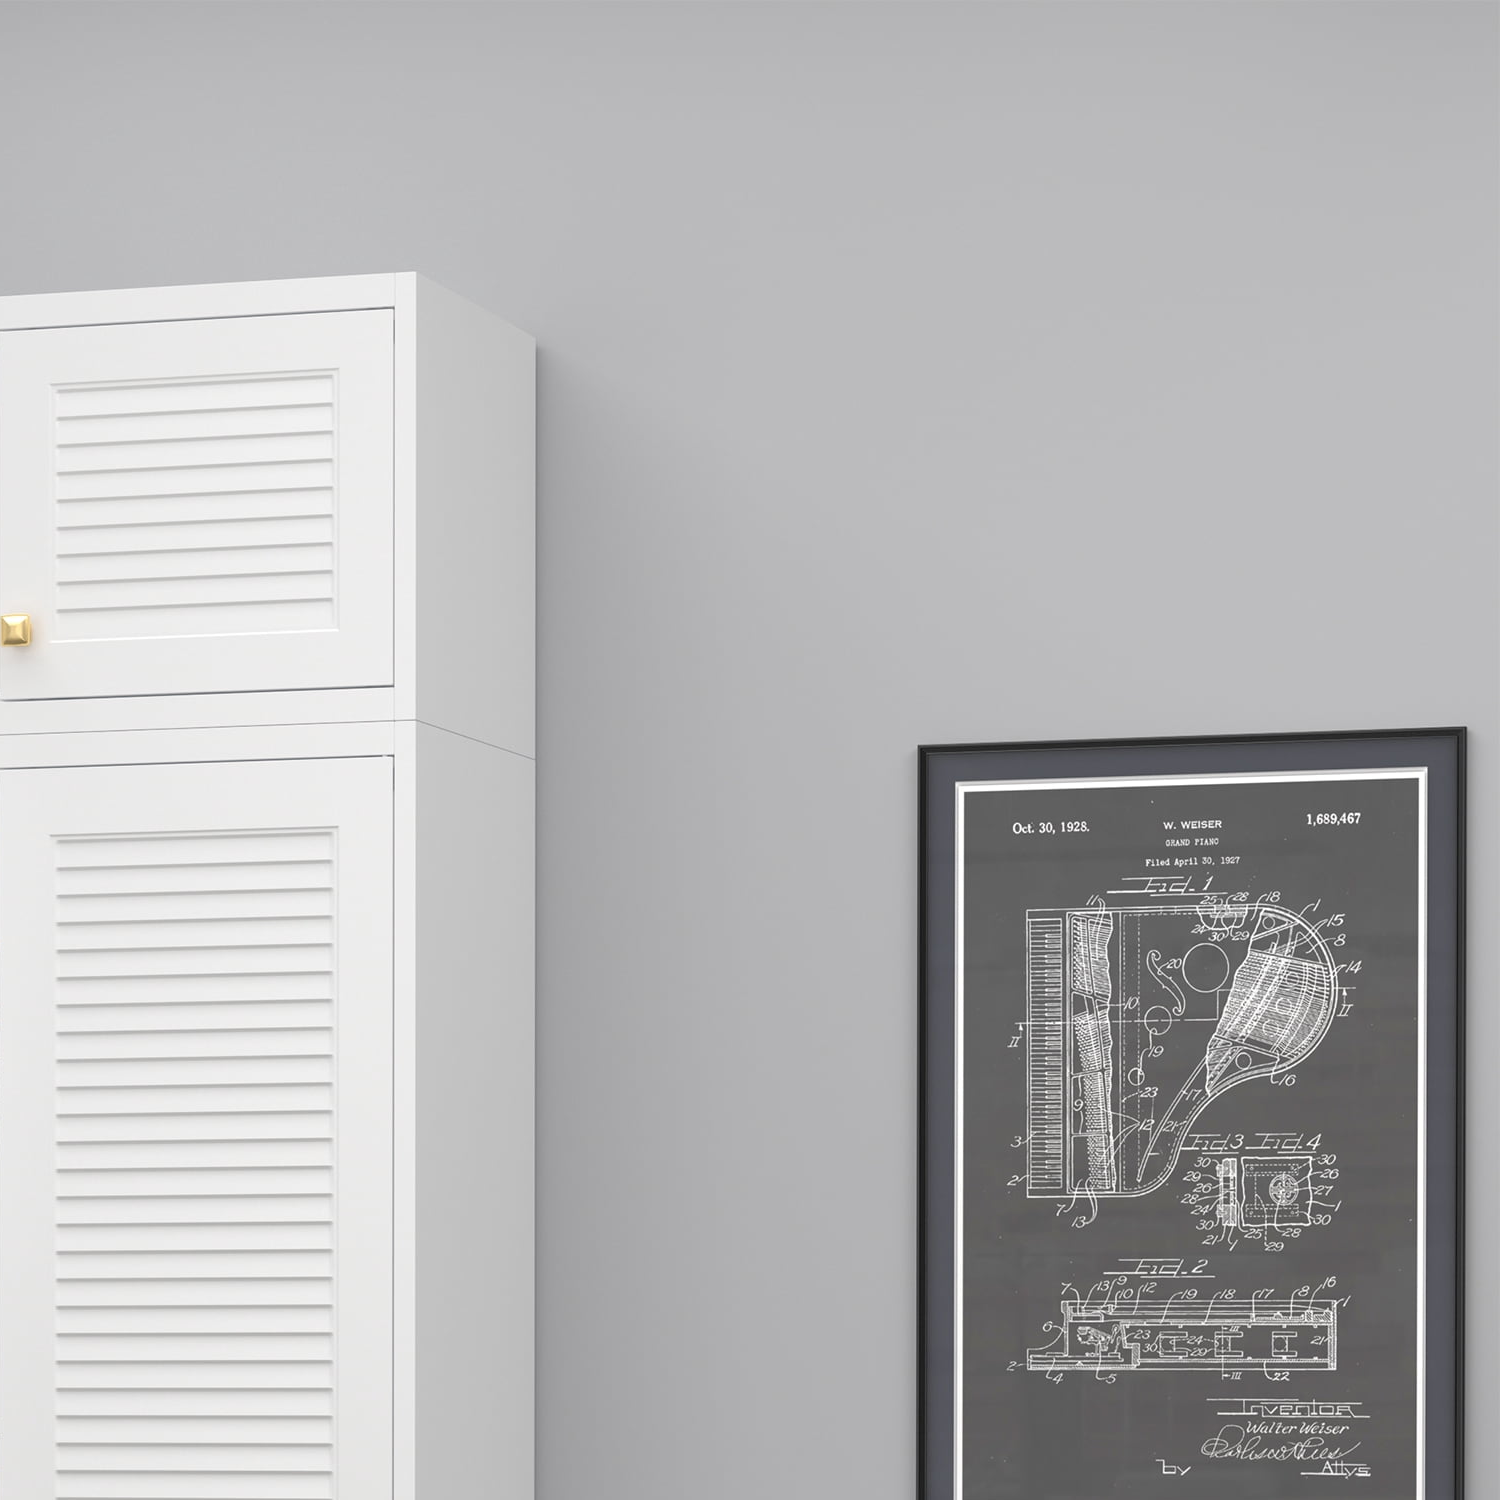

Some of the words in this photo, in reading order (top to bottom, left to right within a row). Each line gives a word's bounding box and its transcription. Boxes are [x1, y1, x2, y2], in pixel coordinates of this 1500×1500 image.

[1163, 821, 1177, 830] W.
[1181, 820, 1222, 829] WEISER
[1306, 813, 1361, 827] 1,689,467
[1012, 822, 1035, 834] Oct.
[1039, 822, 1056, 835] 30,
[1061, 821, 1090, 832] 1928.
[1165, 839, 1190, 847] GRAND
[1194, 838, 1219, 846] PIANO
[1145, 858, 1170, 867] Filed
[1174, 857, 1198, 868] April
[1202, 857, 1215, 866] 30,
[1202, 876, 1213, 891] 1
[1200, 896, 1217, 904] 25
[1233, 892, 1249, 901] 28
[1266, 891, 1281, 902] 18
[1327, 914, 1345, 927] 15
[1191, 925, 1205, 934] 24
[1208, 932, 1225, 941] 30
[1232, 931, 1250, 941] 29
[1334, 934, 1346, 946] 8
[1166, 958, 1182, 969] 20
[1345, 960, 1362, 974] 14
[1124, 997, 1139, 1010] 10
[1148, 1046, 1164, 1057] 19
[1279, 1074, 1296, 1086] 16
[1139, 1087, 1158, 1097] 23
[1073, 1099, 1084, 1111] 9
[1138, 1119, 1155, 1131] 12
[1010, 1136, 1022, 1148] 3
[1230, 1134, 1244, 1149] 3
[1306, 1133, 1321, 1150] 4
[1194, 1159, 1211, 1167] 30
[1317, 1154, 1336, 1165] 30
[1183, 1171, 1201, 1182] 29
[1320, 1169, 1339, 1179] 26
[1007, 1175, 1020, 1186] 2
[1193, 1183, 1212, 1193] 26
[1314, 1185, 1333, 1195] 27
[1181, 1194, 1200, 1204] 28
[1056, 1203, 1065, 1216] 7
[1190, 1205, 1209, 1215] 24
[1071, 1216, 1086, 1228] 13
[1196, 1220, 1214, 1230] 30
[1313, 1214, 1331, 1225] 30
[1244, 1229, 1263, 1239] 25
[1282, 1228, 1301, 1238] 28
[1202, 1235, 1218, 1245] 21
[1265, 1241, 1284, 1251] 29
[1191, 1259, 1208, 1274] 2
[1097, 1280, 1110, 1291] 13
[1116, 1275, 1127, 1286] 9
[1322, 1276, 1336, 1289] 16
[1061, 1282, 1072, 1295] 7
[1142, 1282, 1157, 1293] 12
[1298, 1285, 1310, 1297] 8
[1118, 1288, 1133, 1299] 10
[1180, 1288, 1198, 1299] 19
[1219, 1289, 1236, 1299] 18
[1258, 1288, 1274, 1299] 17
[1042, 1321, 1053, 1332] 6
[1134, 1330, 1151, 1339] 23
[1007, 1361, 1017, 1371] 2
[1052, 1373, 1063, 1384] 4
[1105, 1373, 1117, 1384] 5
[1272, 1371, 1290, 1381] 22
[1247, 1421, 1297, 1434] Walter
[1300, 1421, 1350, 1435] Weiser
[1156, 1459, 1191, 1476] by
